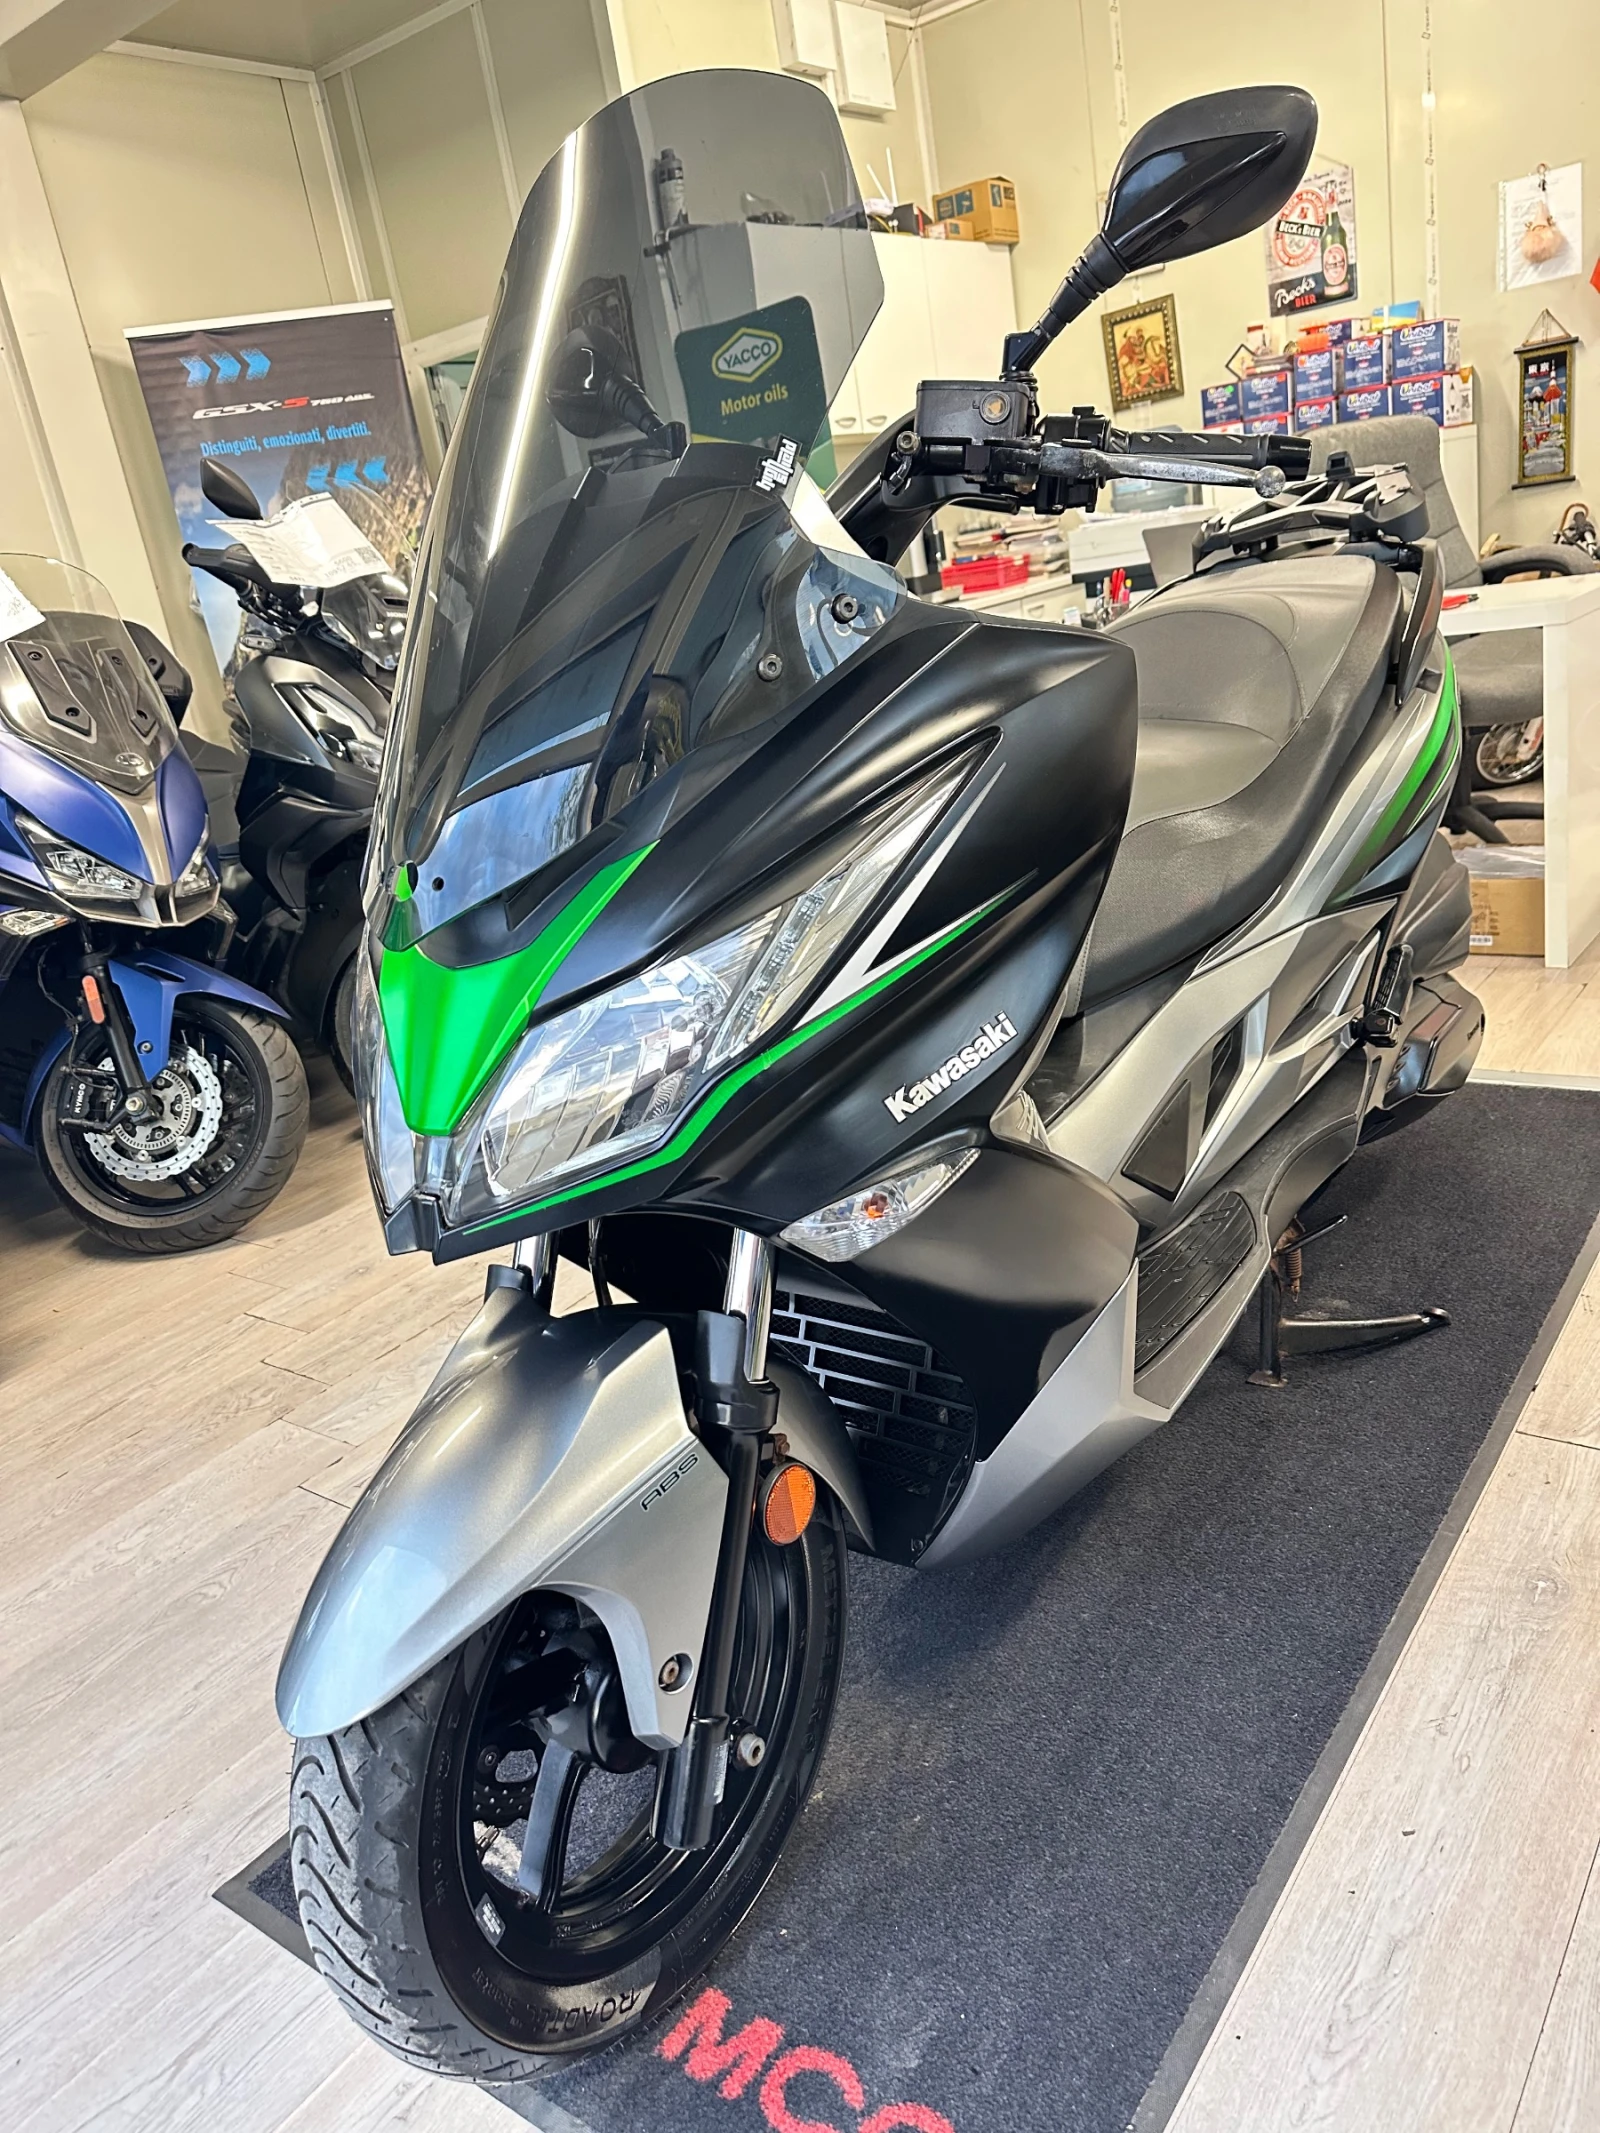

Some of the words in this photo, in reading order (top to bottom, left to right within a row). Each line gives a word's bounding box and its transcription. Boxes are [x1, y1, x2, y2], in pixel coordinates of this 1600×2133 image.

[1295, 294, 1317, 308] BIER
[723, 340, 772, 369] YACCO
[193, 396, 310, 420] GSX-S
[720, 392, 761, 417] Motor
[764, 383, 789, 402] oils
[200, 435, 262, 458] Distinguiti,
[263, 427, 326, 449] emozionati,
[326, 420, 372, 441] divertiti.
[883, 1010, 1019, 1124] Kawasaki
[74, 1083, 87, 1114] KYMCO
[640, 1453, 699, 1511] ABS
[527, 1987, 642, 2034] ROADTEC
